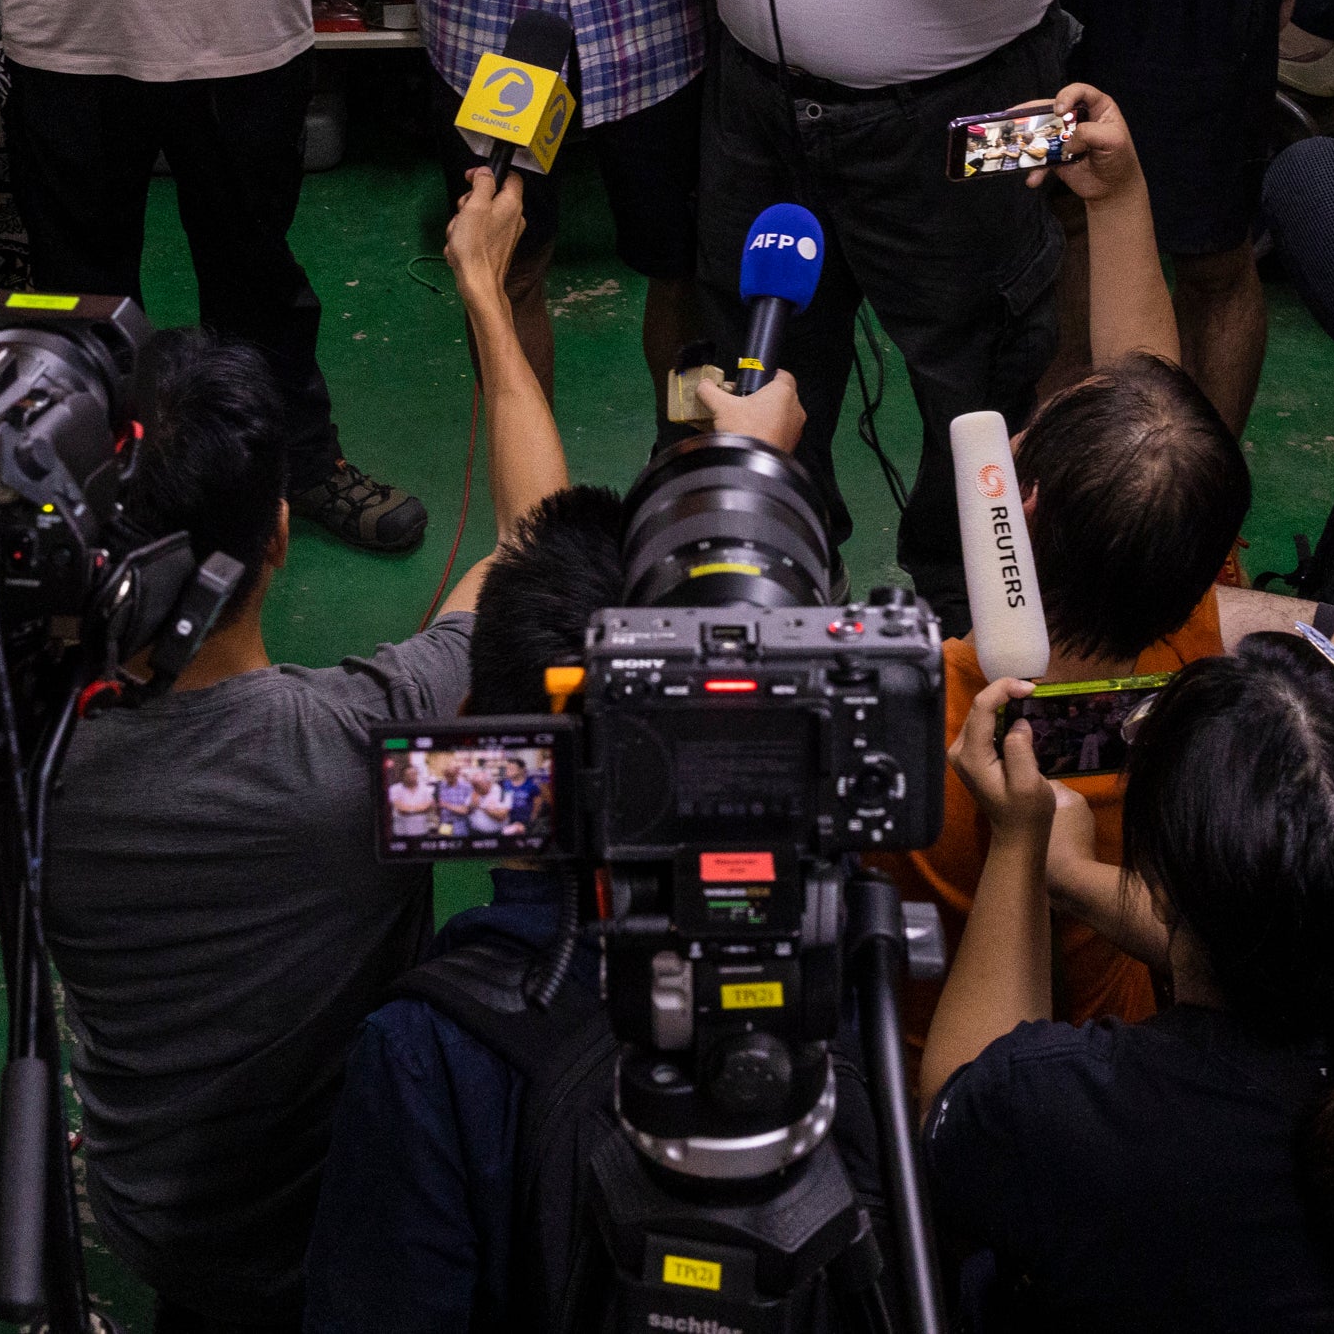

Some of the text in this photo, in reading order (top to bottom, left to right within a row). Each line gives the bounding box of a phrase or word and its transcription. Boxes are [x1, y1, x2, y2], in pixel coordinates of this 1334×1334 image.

[471, 113, 520, 133] CHANNEL C
[749, 233, 795, 252] AFP
[991, 507, 1026, 609] REUTERS
[732, 988, 774, 1005] TP(2)
[672, 1263, 715, 1286] TP(2)
[648, 1311, 743, 1334] sachtler
